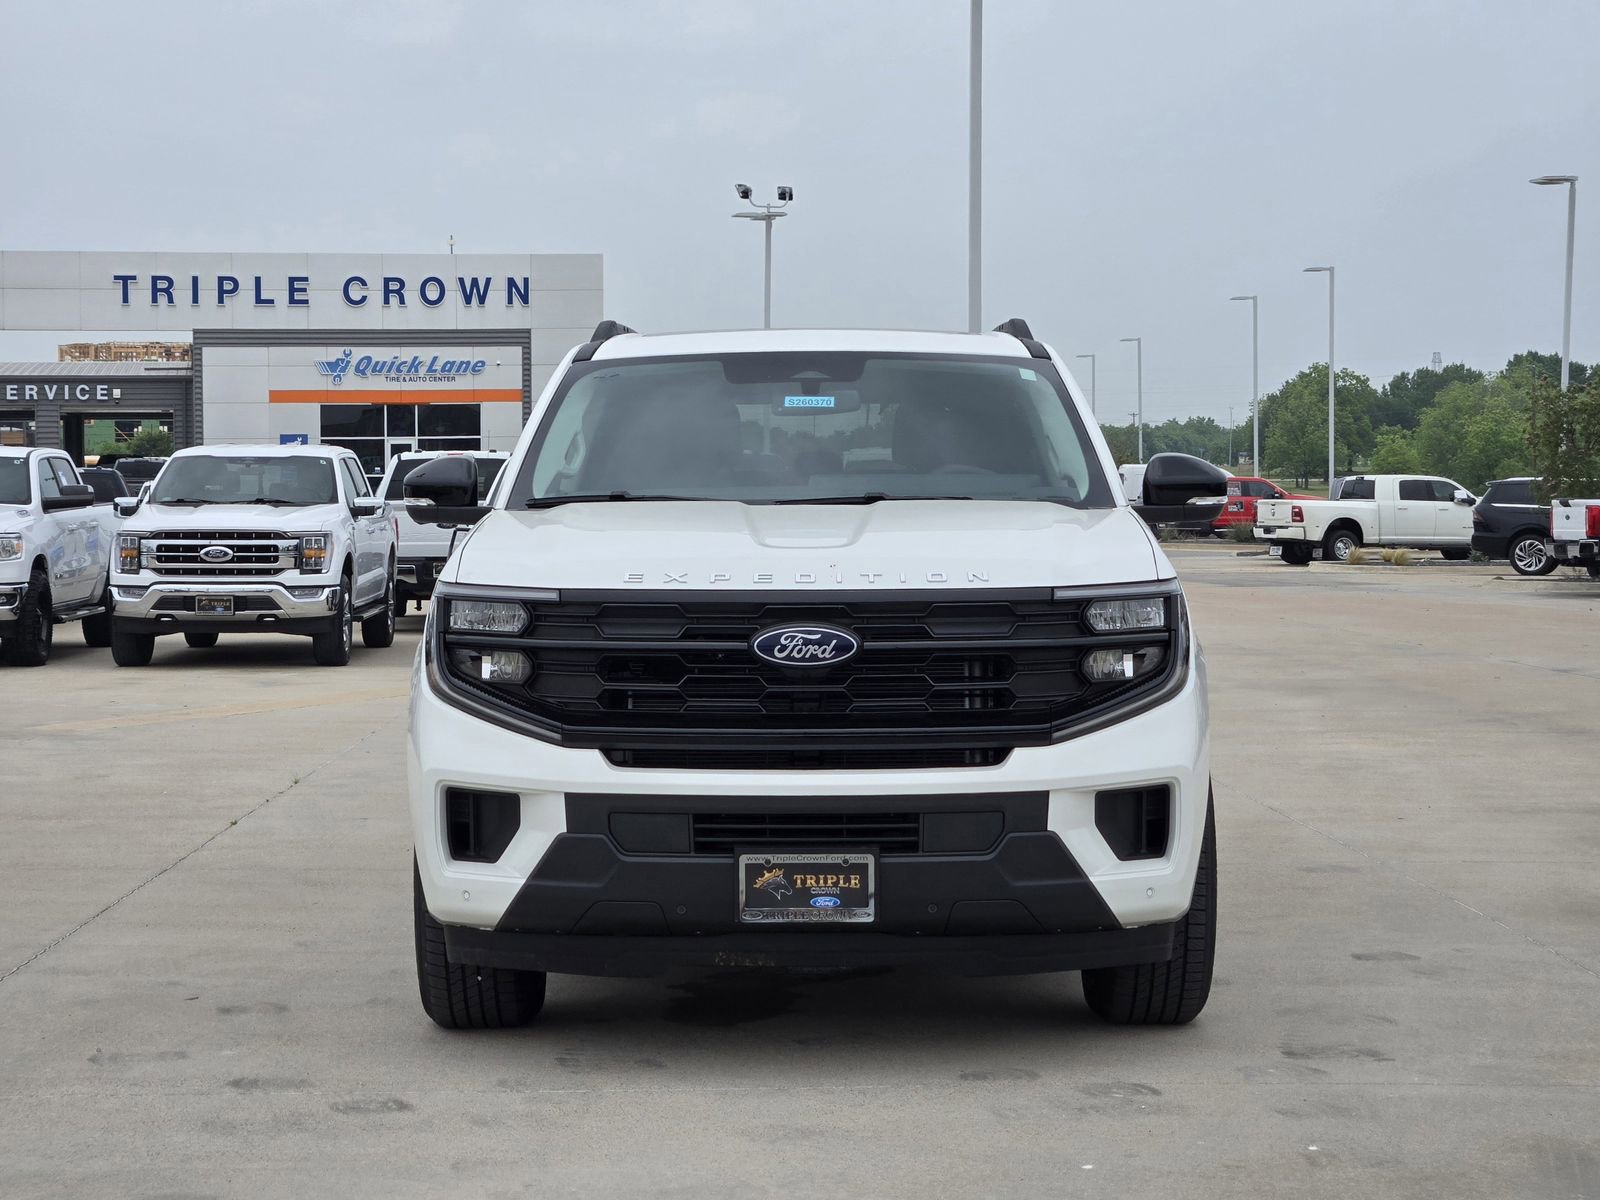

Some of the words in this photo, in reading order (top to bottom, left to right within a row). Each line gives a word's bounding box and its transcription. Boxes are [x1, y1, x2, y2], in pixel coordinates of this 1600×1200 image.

[113, 275, 310, 306] TRIPLE
[342, 275, 531, 307] CROWN
[354, 355, 423, 377] Quick
[425, 355, 487, 375] Lane
[6, 384, 109, 400] ERVICE
[788, 398, 832, 406] S260370
[622, 571, 990, 584] EXPEDITION
[773, 632, 838, 658] Ford
[793, 874, 861, 889] TRIPLE
[810, 887, 840, 895] CROWN
[815, 898, 835, 907] Ford
